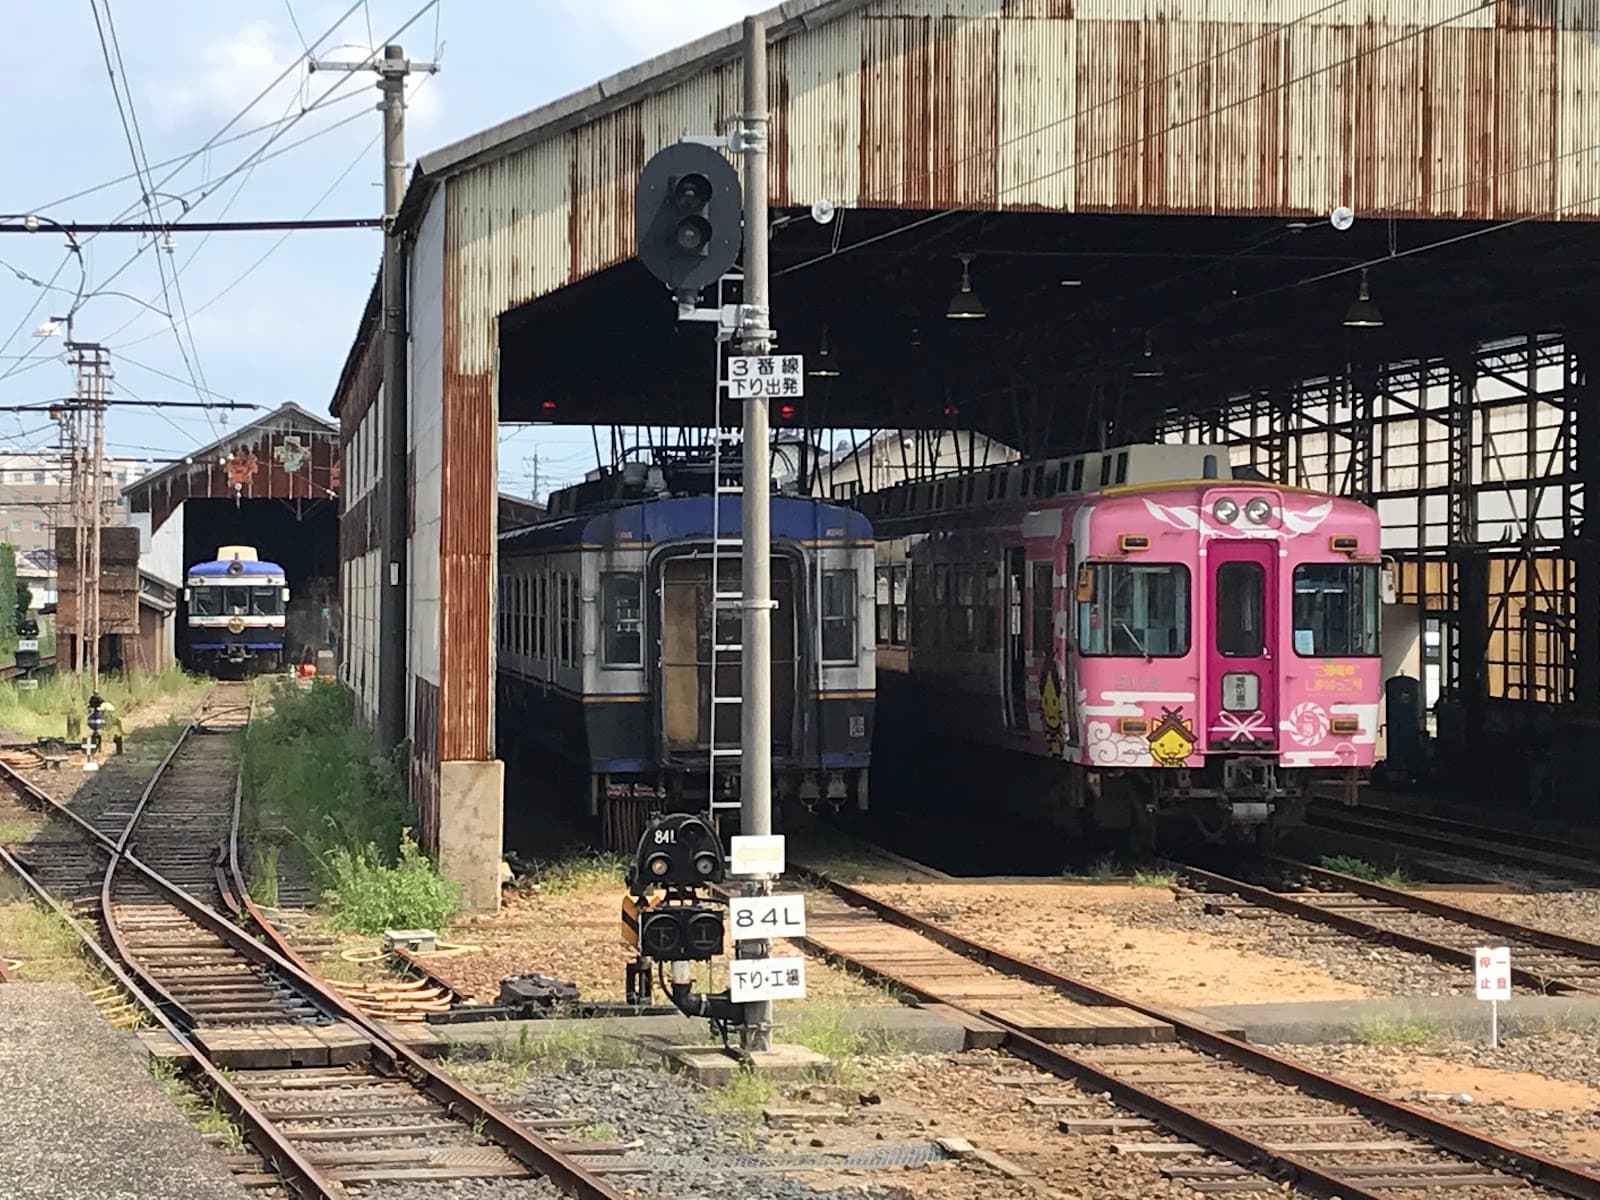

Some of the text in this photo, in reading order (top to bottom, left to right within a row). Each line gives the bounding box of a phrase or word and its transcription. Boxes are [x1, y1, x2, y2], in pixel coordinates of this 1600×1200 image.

[732, 357, 799, 376] 3番線
[732, 377, 798, 396] 下り出発
[654, 829, 677, 844] 84L
[736, 907, 801, 928] 84L
